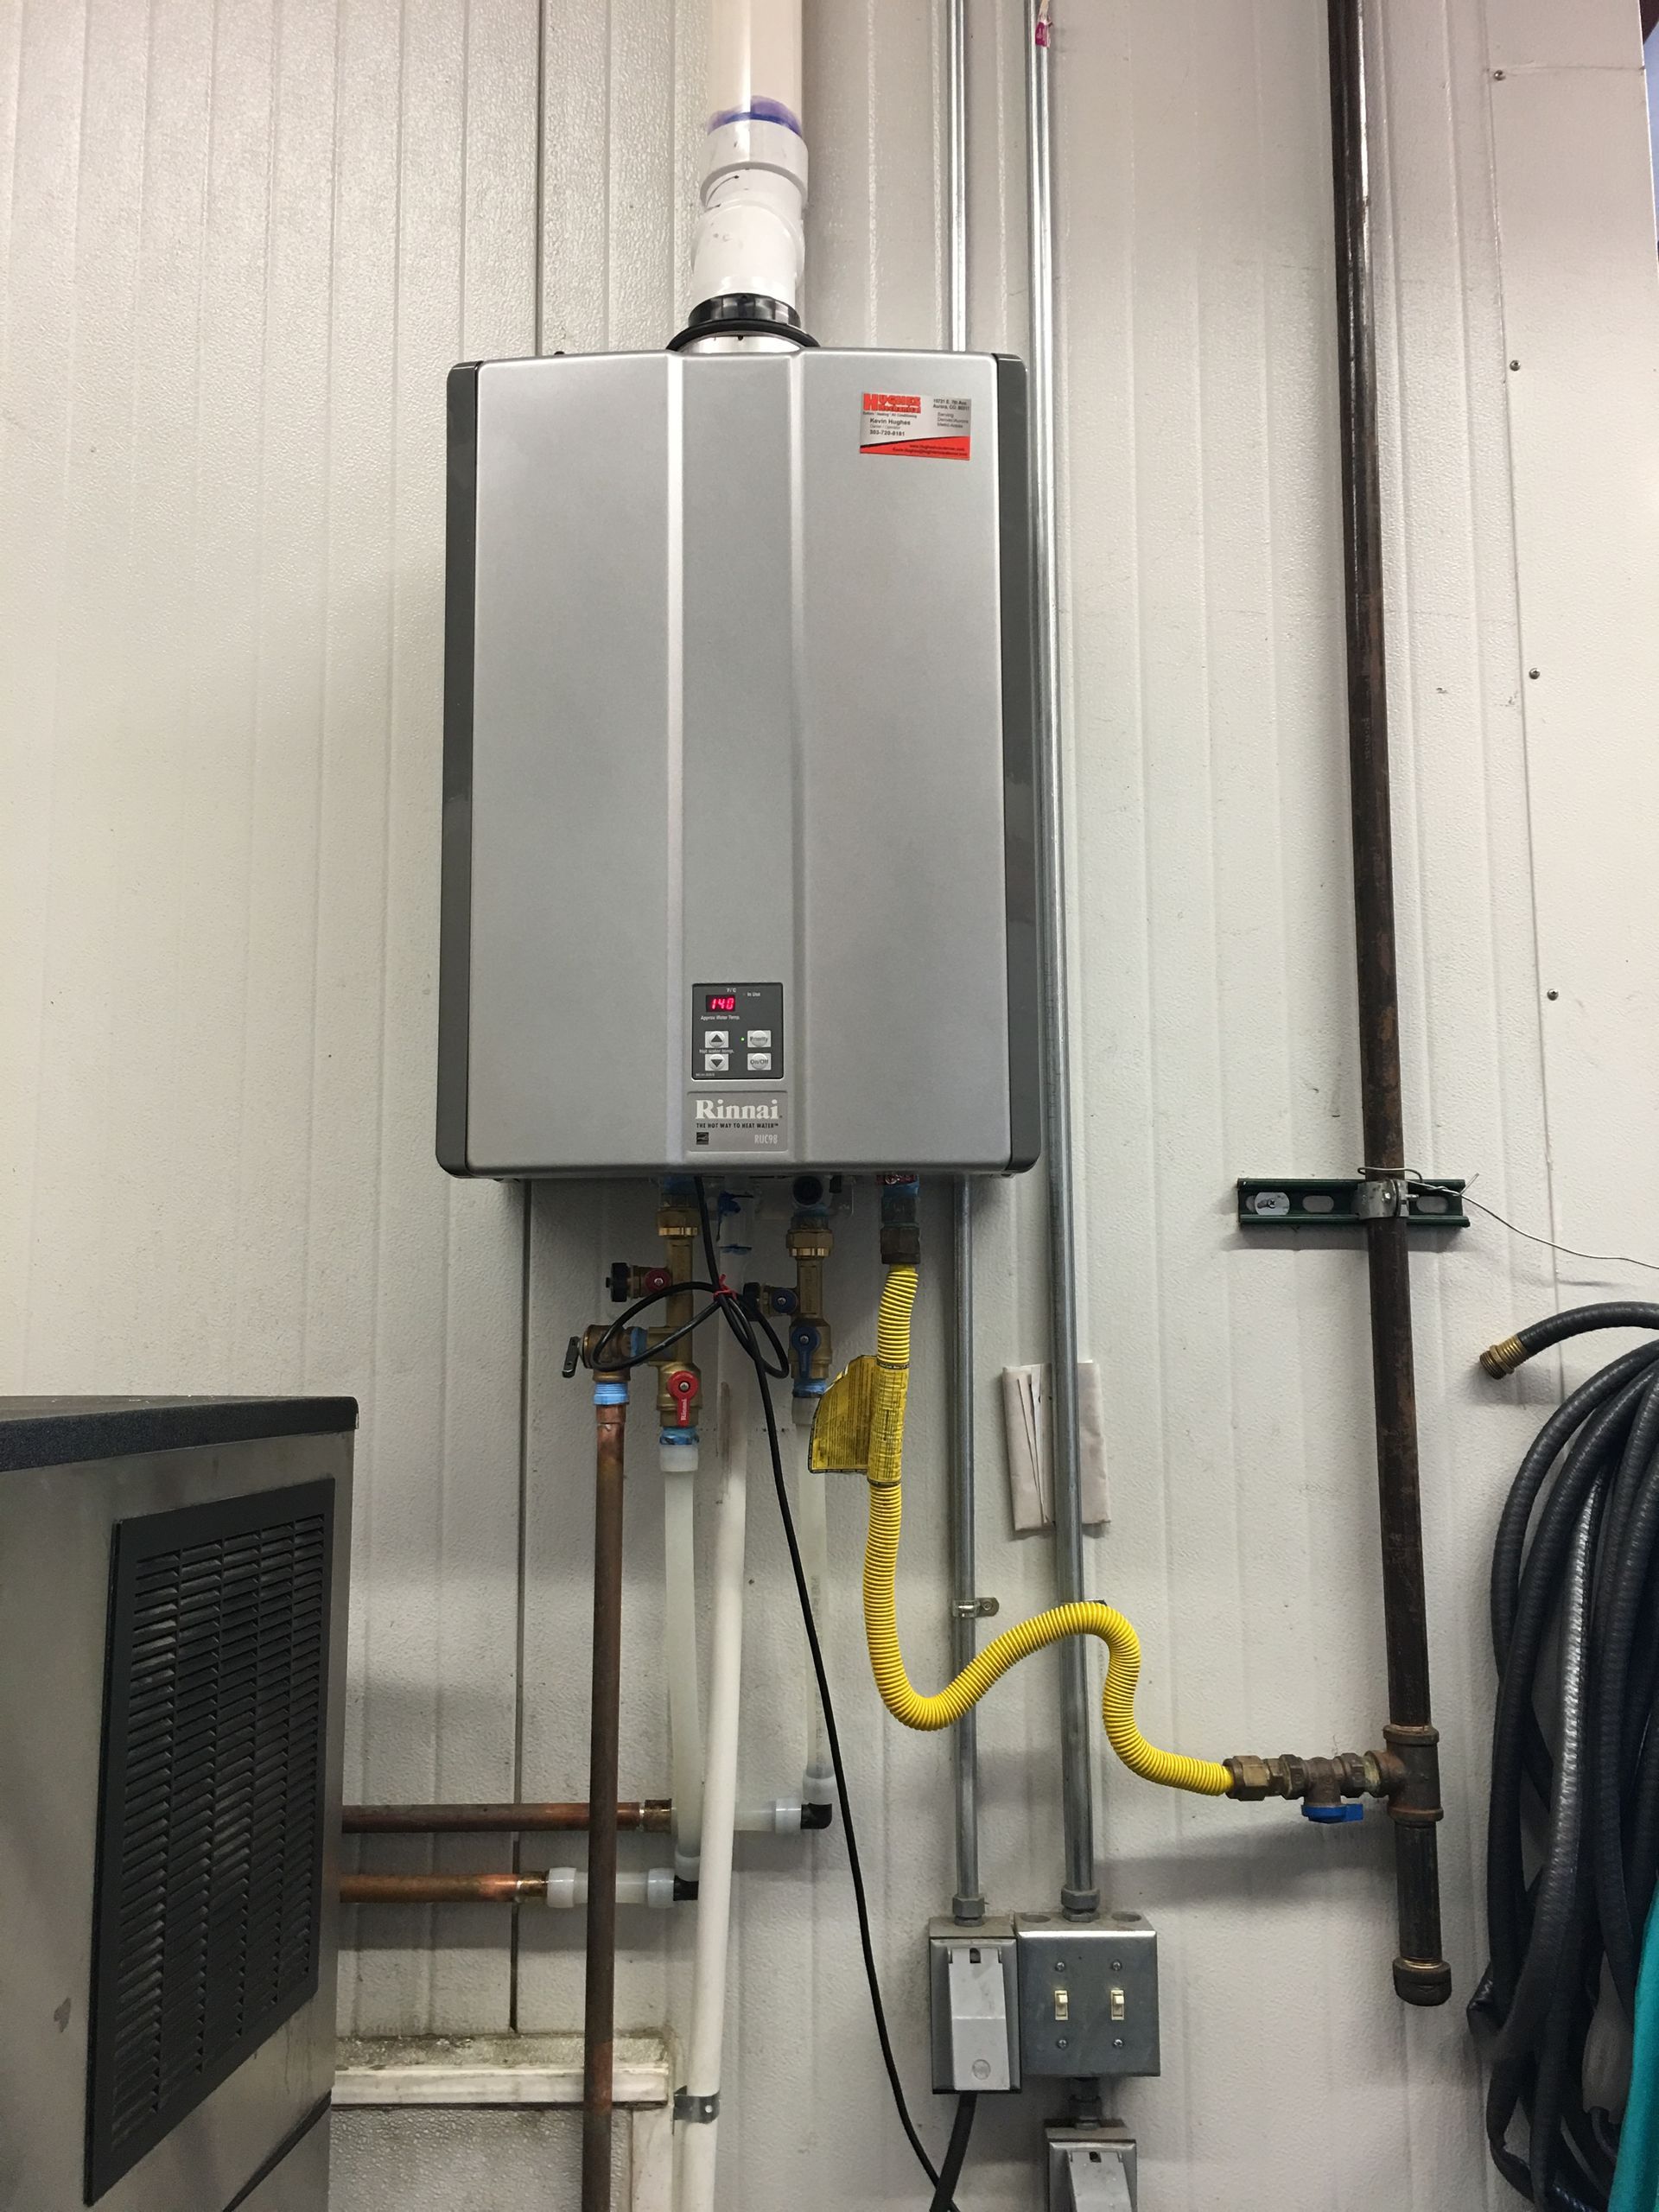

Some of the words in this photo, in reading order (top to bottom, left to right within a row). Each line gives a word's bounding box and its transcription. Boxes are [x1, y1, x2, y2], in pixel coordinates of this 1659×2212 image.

[711, 997, 734, 1010] 140
[695, 1099, 779, 1120] Rinnai
[754, 1134, 778, 1144] RUC98
